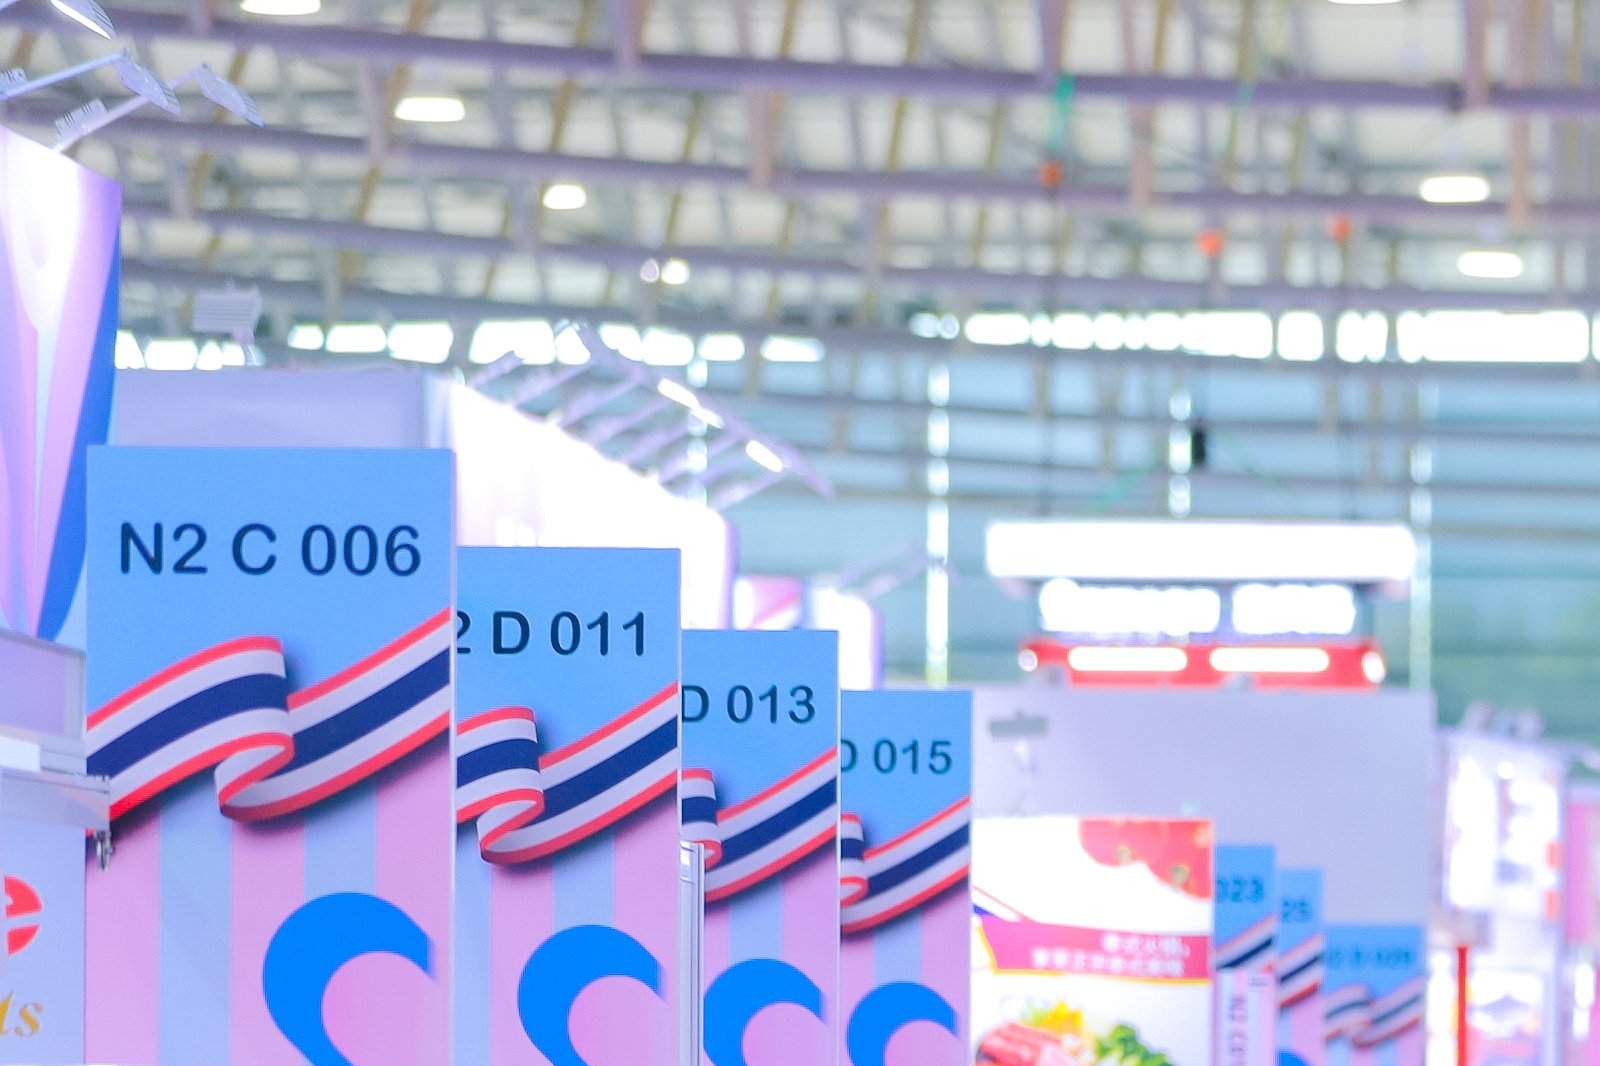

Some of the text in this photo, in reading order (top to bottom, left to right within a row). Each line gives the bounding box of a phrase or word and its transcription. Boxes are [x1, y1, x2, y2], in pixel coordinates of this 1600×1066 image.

[120, 523, 421, 576] N2 C 006
[457, 611, 646, 656] 2 D 011
[682, 685, 815, 723] D 013
[874, 740, 952, 773] 015
